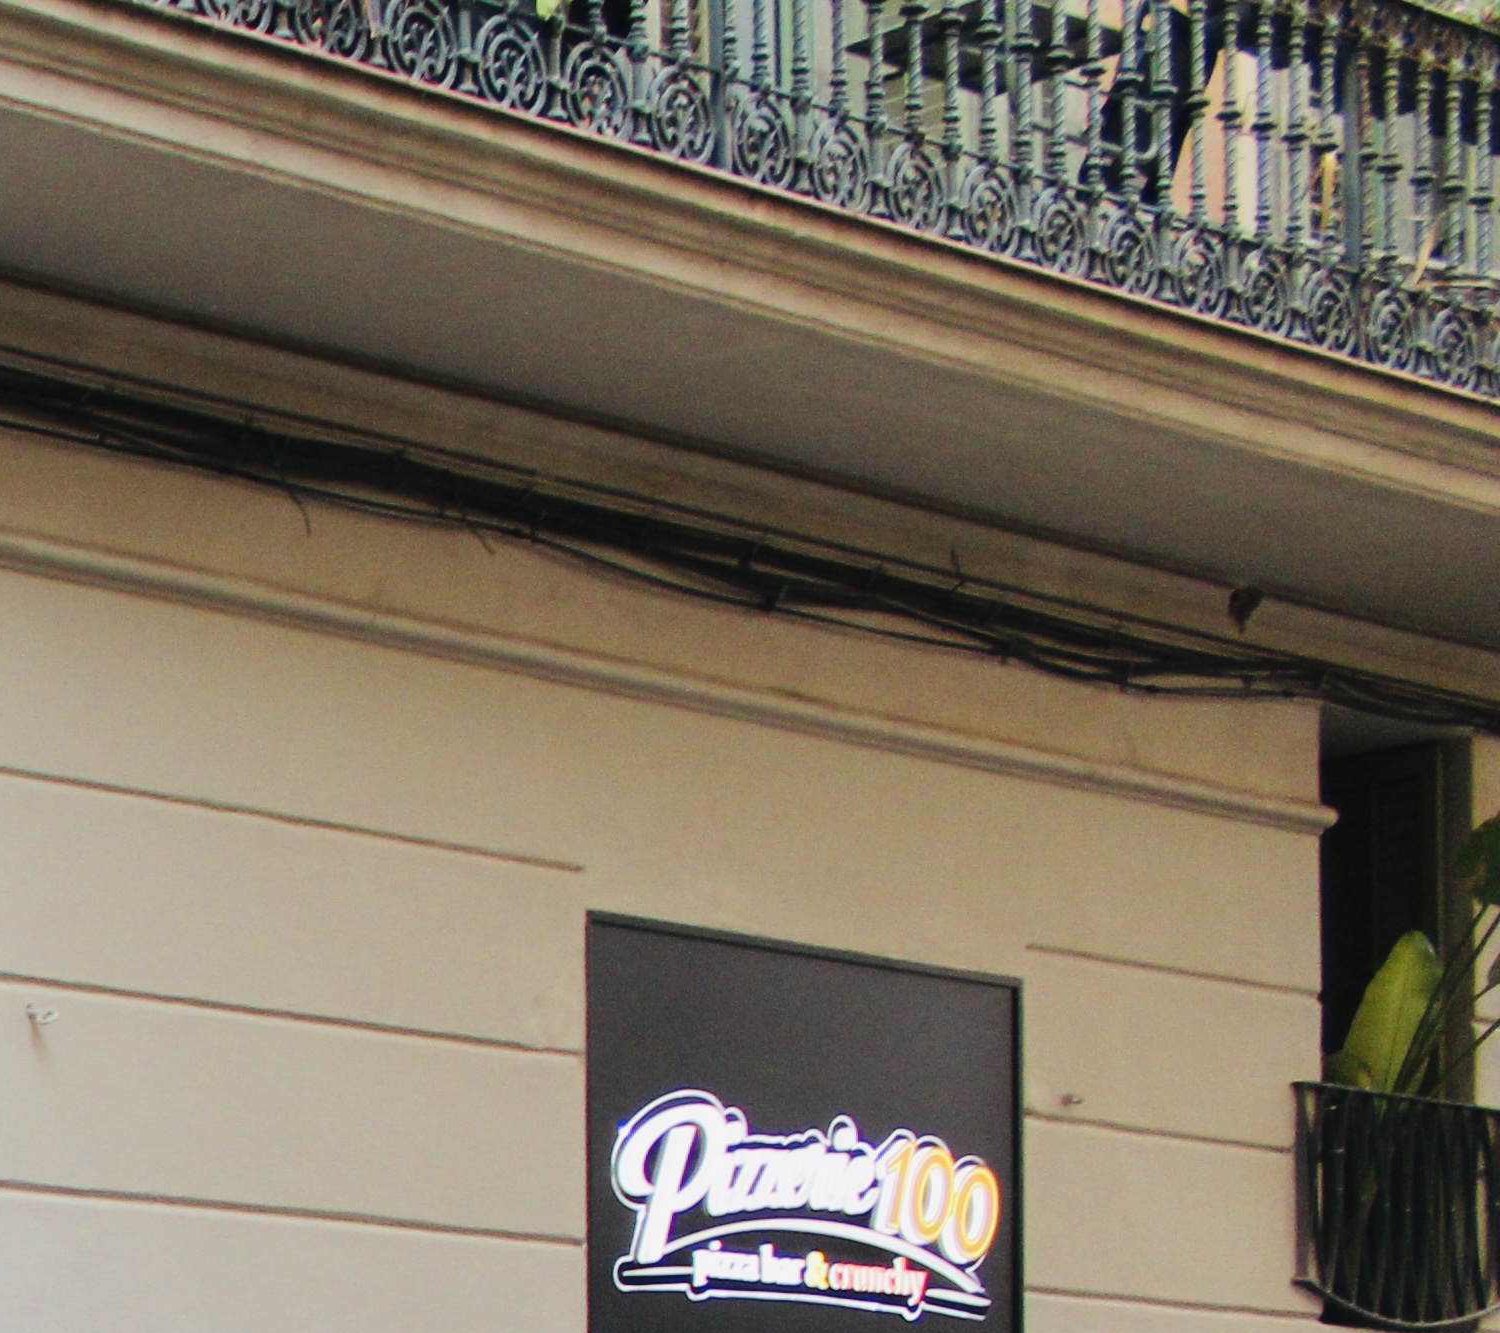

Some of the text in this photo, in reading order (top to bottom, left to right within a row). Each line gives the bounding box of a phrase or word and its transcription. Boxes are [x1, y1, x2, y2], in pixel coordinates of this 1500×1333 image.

[871, 1137, 1001, 1265] 100
[803, 1250, 830, 1290] &
[828, 1256, 929, 1307] crunchy
